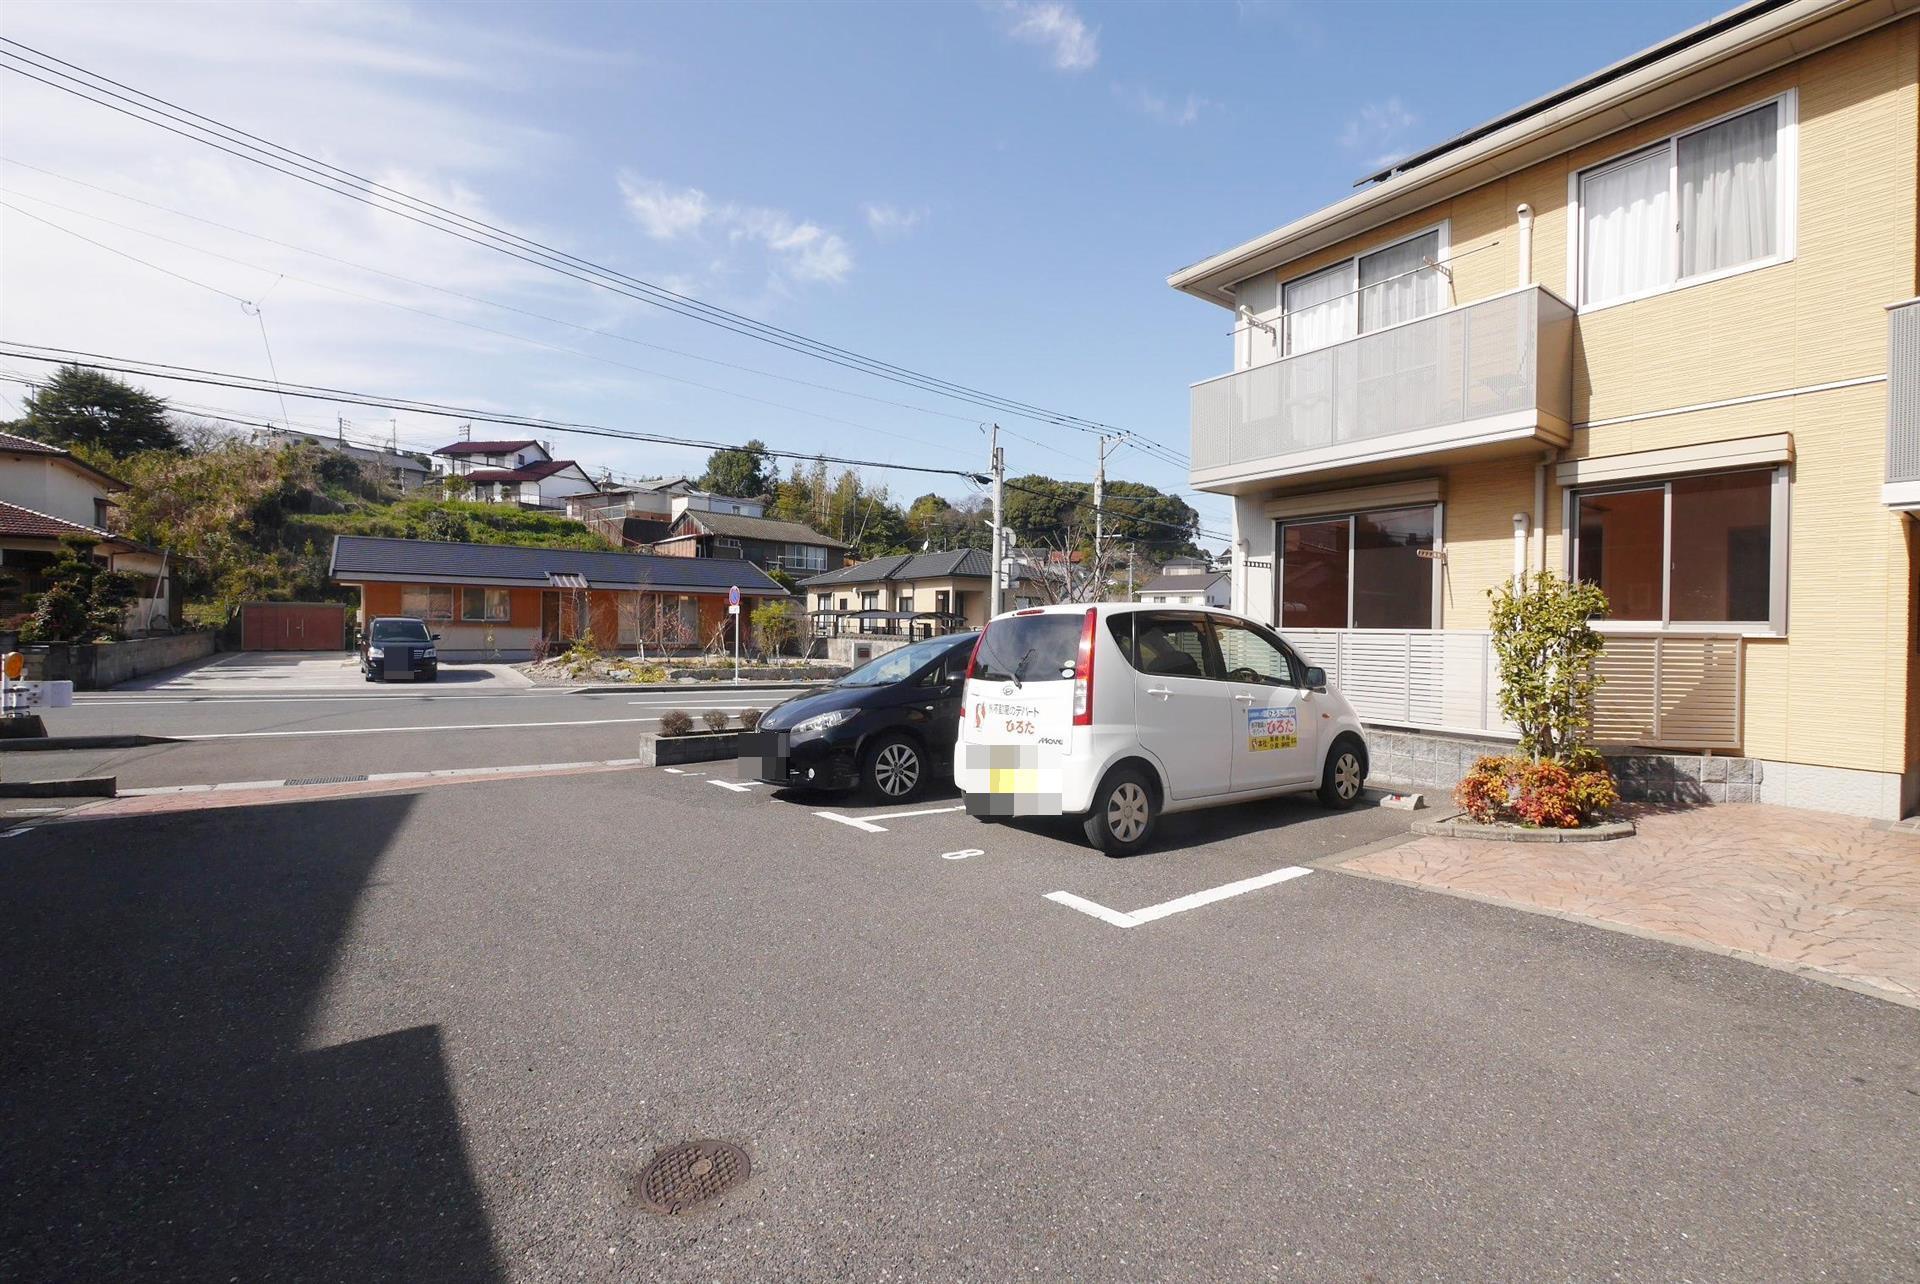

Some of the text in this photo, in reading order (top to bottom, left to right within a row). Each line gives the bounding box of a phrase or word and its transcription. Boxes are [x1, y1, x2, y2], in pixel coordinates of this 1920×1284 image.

[1006, 720, 1035, 735] ひろた
[1267, 719, 1294, 734] ひろた
